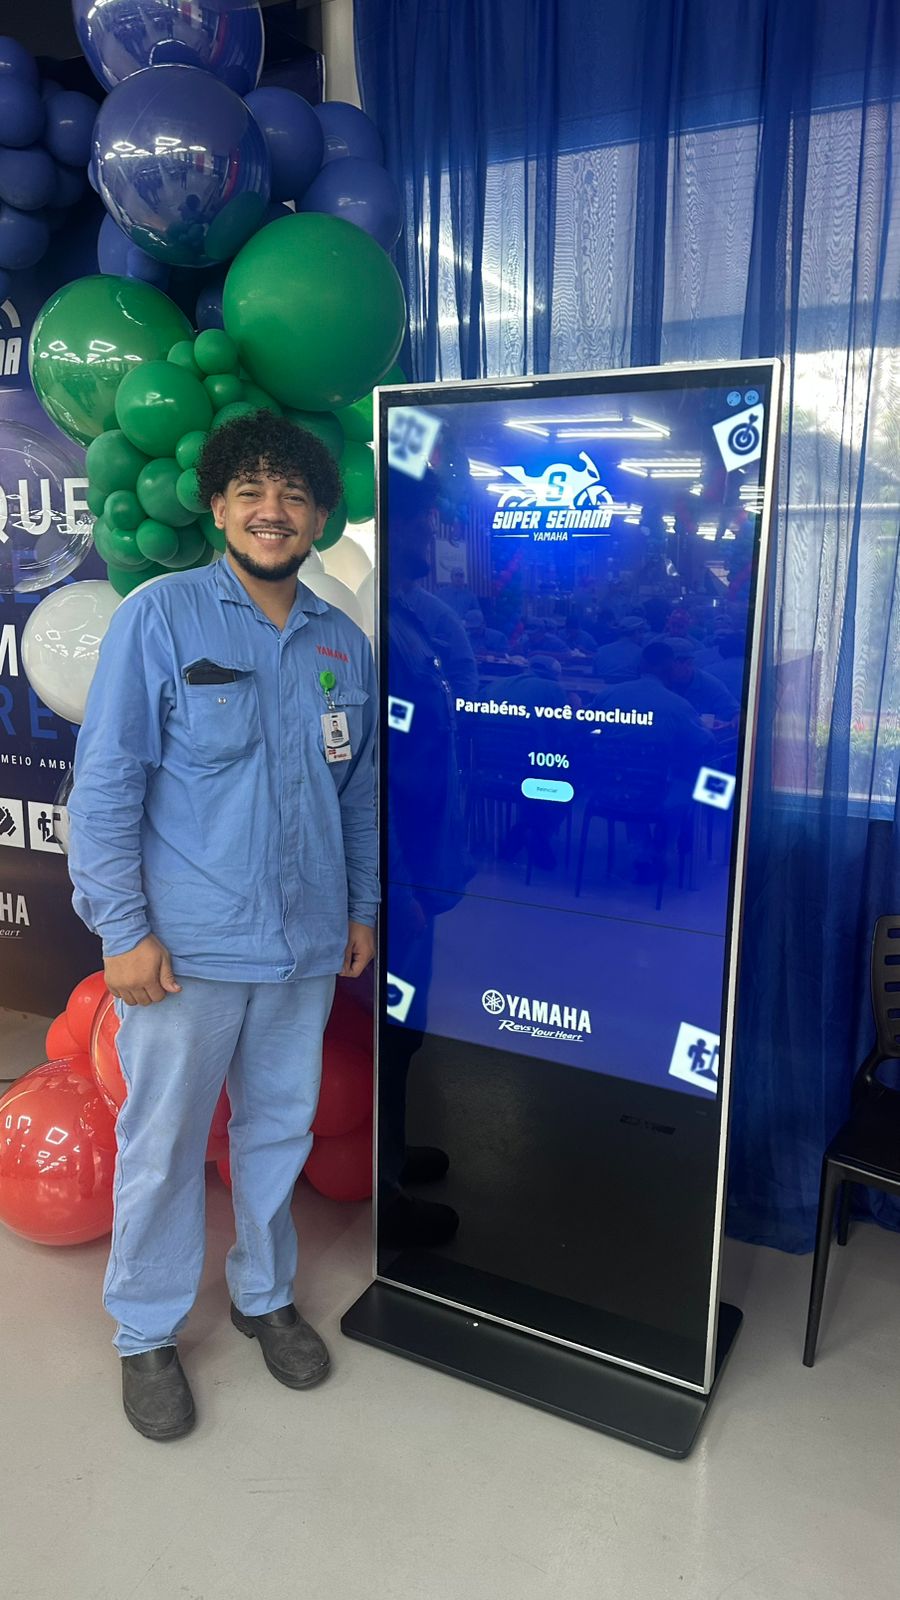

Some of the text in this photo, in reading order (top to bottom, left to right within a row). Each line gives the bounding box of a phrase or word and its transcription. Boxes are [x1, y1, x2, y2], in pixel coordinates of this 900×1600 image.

[492, 508, 613, 530] SUPER SEMANA
[533, 532, 568, 541] YAMAHA
[316, 644, 349, 662] YAMAHA
[455, 698, 654, 726] Parabéns, você concluiu!
[1, 754, 32, 766] MEIO
[528, 751, 570, 769] 100%
[506, 994, 592, 1034] YAMAHA
